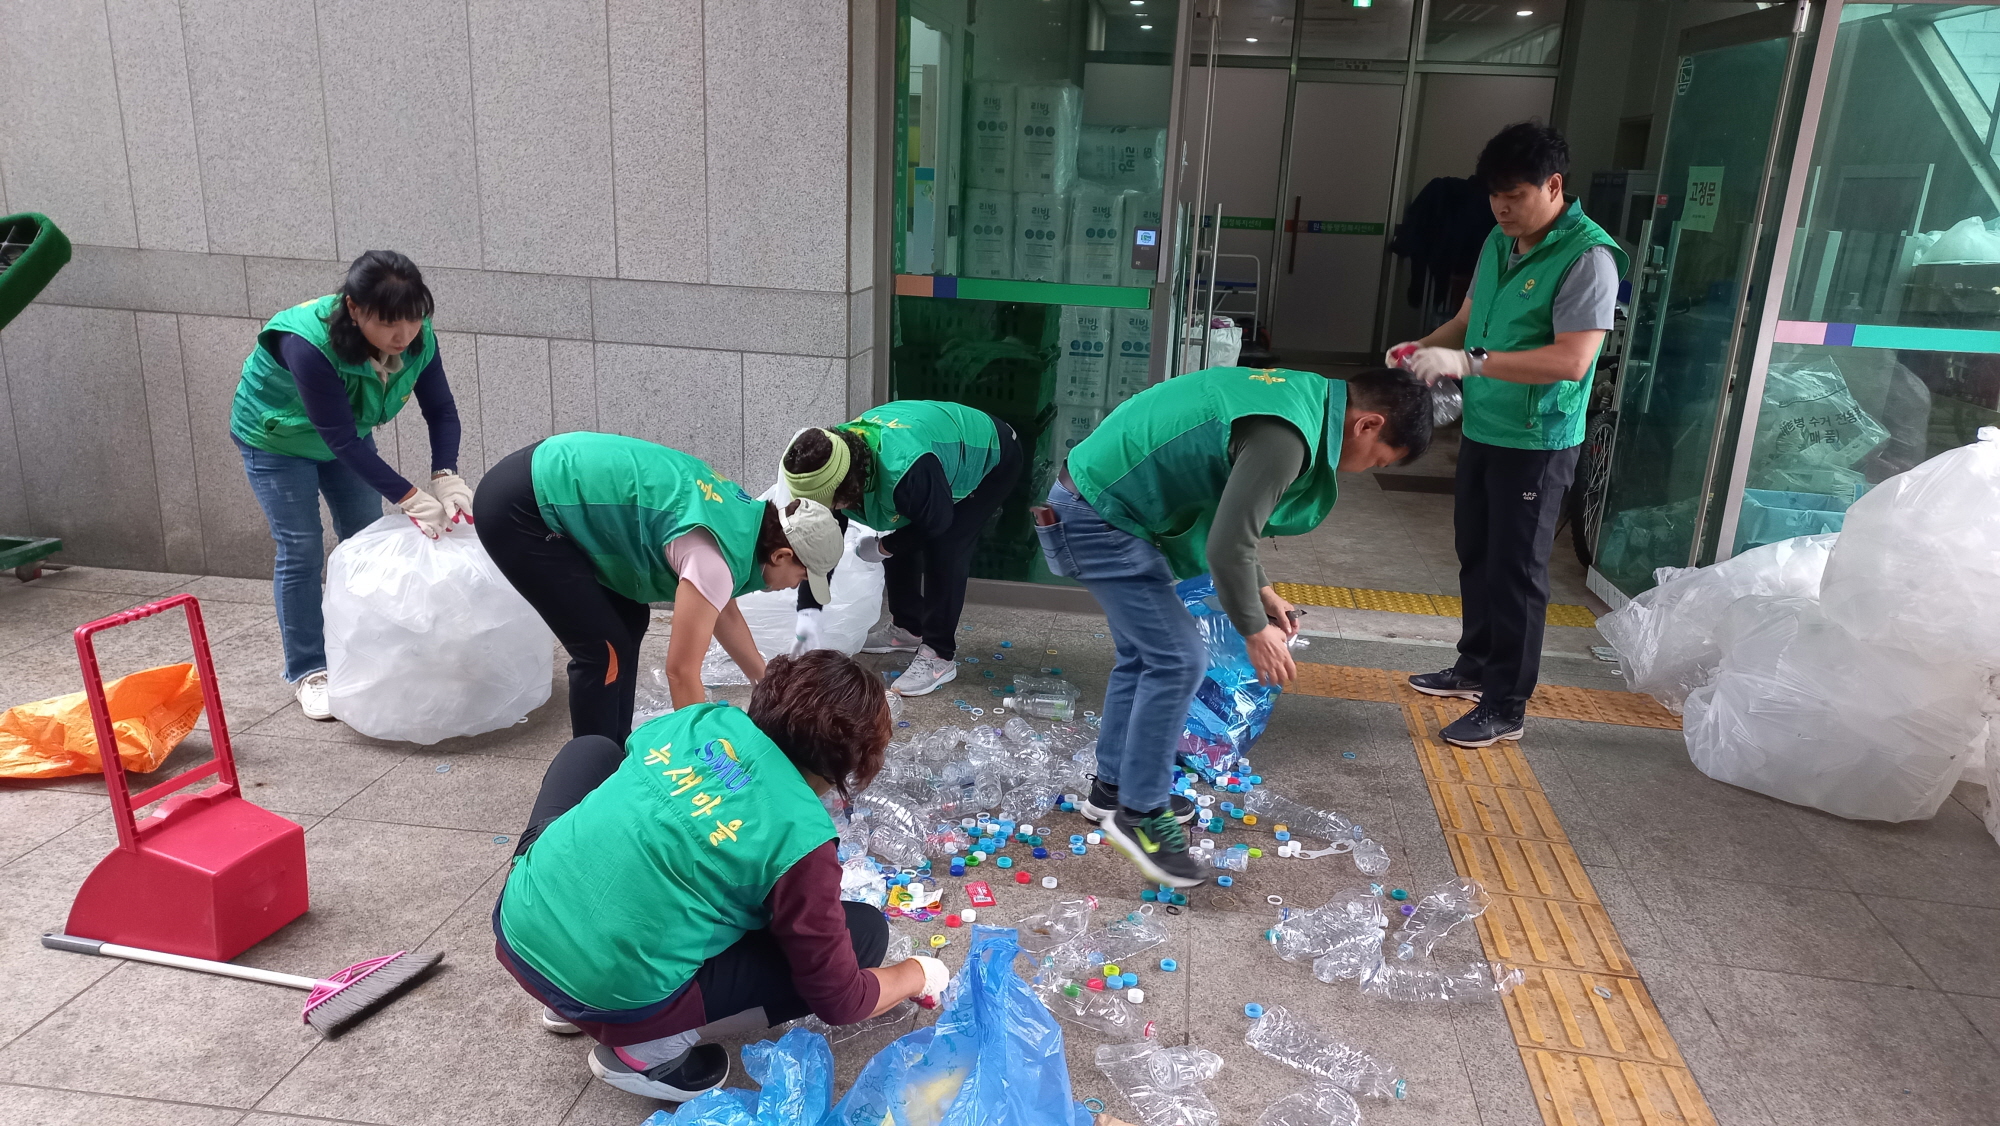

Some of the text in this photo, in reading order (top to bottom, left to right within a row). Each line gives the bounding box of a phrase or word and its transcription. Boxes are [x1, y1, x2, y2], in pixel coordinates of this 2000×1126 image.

[983, 97, 1001, 111] 리빙
[1031, 102, 1050, 116] 리빙
[1119, 146, 1135, 174] 리빙
[1689, 181, 1717, 207] 고정문
[978, 202, 998, 216] 리빙
[1031, 206, 1051, 221] 리빙
[1092, 206, 1112, 219] 리빙
[1078, 317, 1099, 331] 리빙
[1129, 318, 1150, 331] 리빙
[1071, 417, 1091, 430] 리빙
[1809, 415, 1831, 427] 수거
[695, 740, 752, 793] SMU
